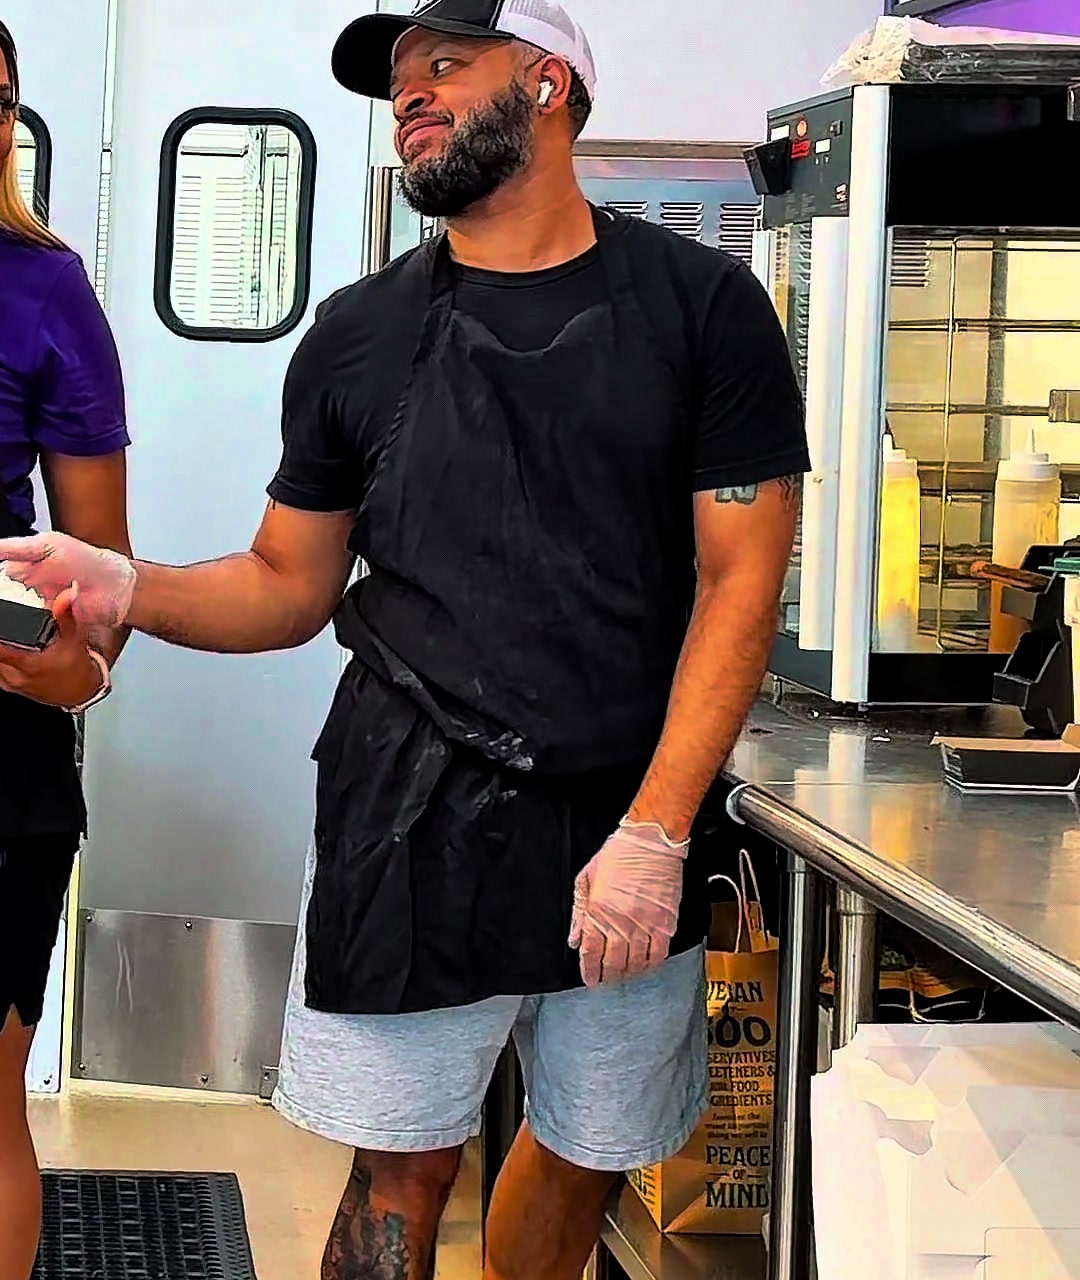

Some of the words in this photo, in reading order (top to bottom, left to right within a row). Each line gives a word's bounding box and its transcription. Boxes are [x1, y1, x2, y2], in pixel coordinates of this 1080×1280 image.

[708, 1050, 775, 1064] SERVATIVES
[709, 1065, 765, 1078] EETENERS
[710, 1094, 772, 1107] GREDIENTS
[706, 1145, 771, 1167] PEACE
[705, 1181, 769, 1209] MIND
